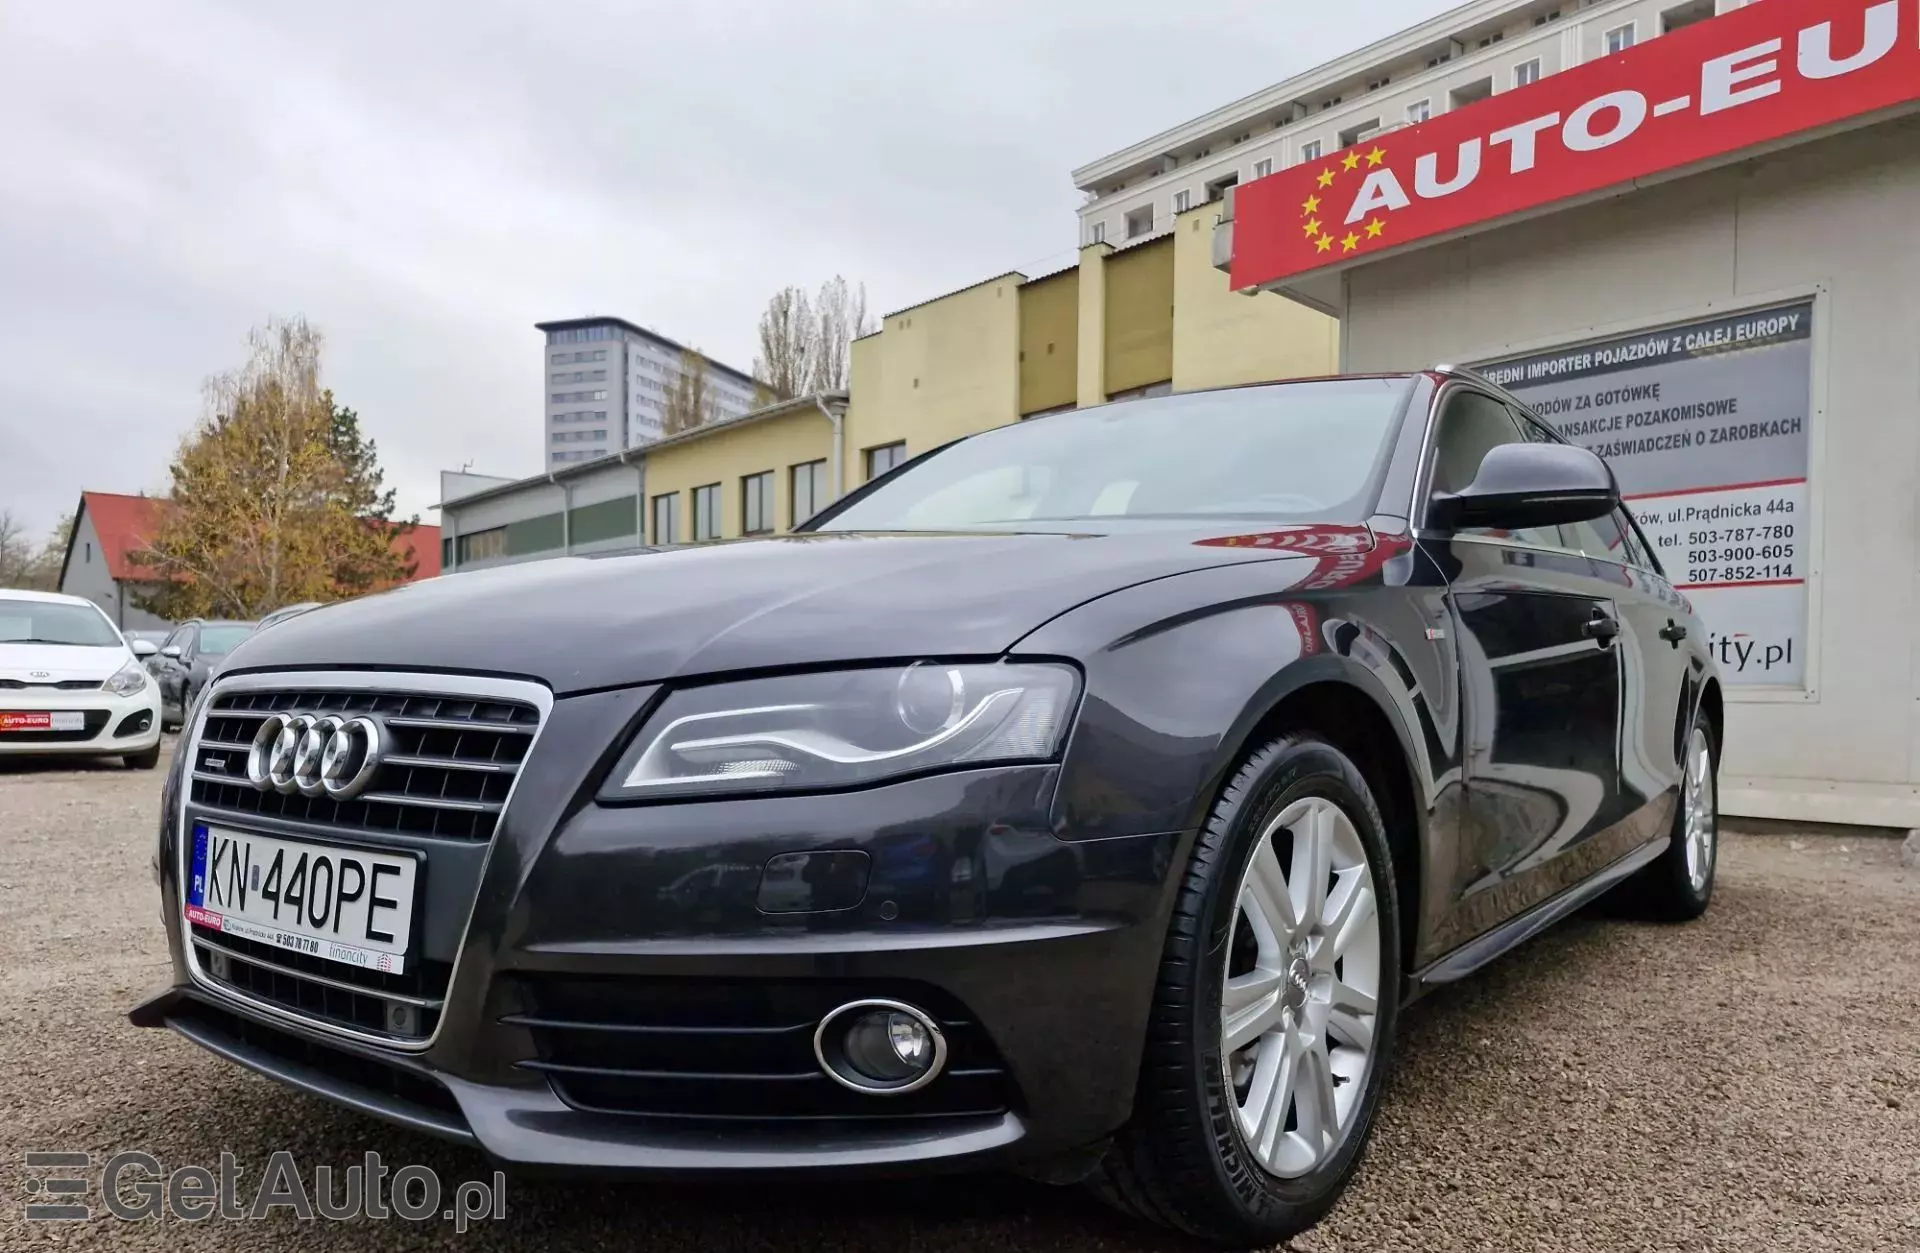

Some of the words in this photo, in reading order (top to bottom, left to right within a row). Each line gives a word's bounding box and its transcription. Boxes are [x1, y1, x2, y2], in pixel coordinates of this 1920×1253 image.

[1344, 0, 1920, 225] AUTO-EU
[1528, 353, 1591, 379] IMPORTER
[1595, 339, 1669, 367] POJAZDÓW
[1672, 336, 1682, 352] Z
[1685, 327, 1731, 350] CAŁEJ
[1736, 314, 1799, 340] EUROPY
[1575, 395, 1591, 410] ZA
[1595, 383, 1661, 406] GOTÓWKĘ
[1626, 398, 1737, 428] POZAKOMISOWE
[1597, 428, 1691, 458] ZAŚWIADCZEŃ
[1695, 431, 1706, 446] O
[1709, 417, 1801, 444] ZAROBKACH
[1668, 502, 1761, 523] ul.Prądnicka
[1766, 499, 1794, 514] 44a
[1658, 533, 1682, 547] tel.
[1688, 524, 1794, 545] 503-787-780
[1688, 544, 1794, 564] 503-900-605
[1688, 563, 1793, 582] 507-852-114
[194, 874, 203, 893] PL
[208, 836, 251, 912] KN
[261, 848, 401, 944] 440PE
[188, 909, 221, 928] AUTO-EURO
